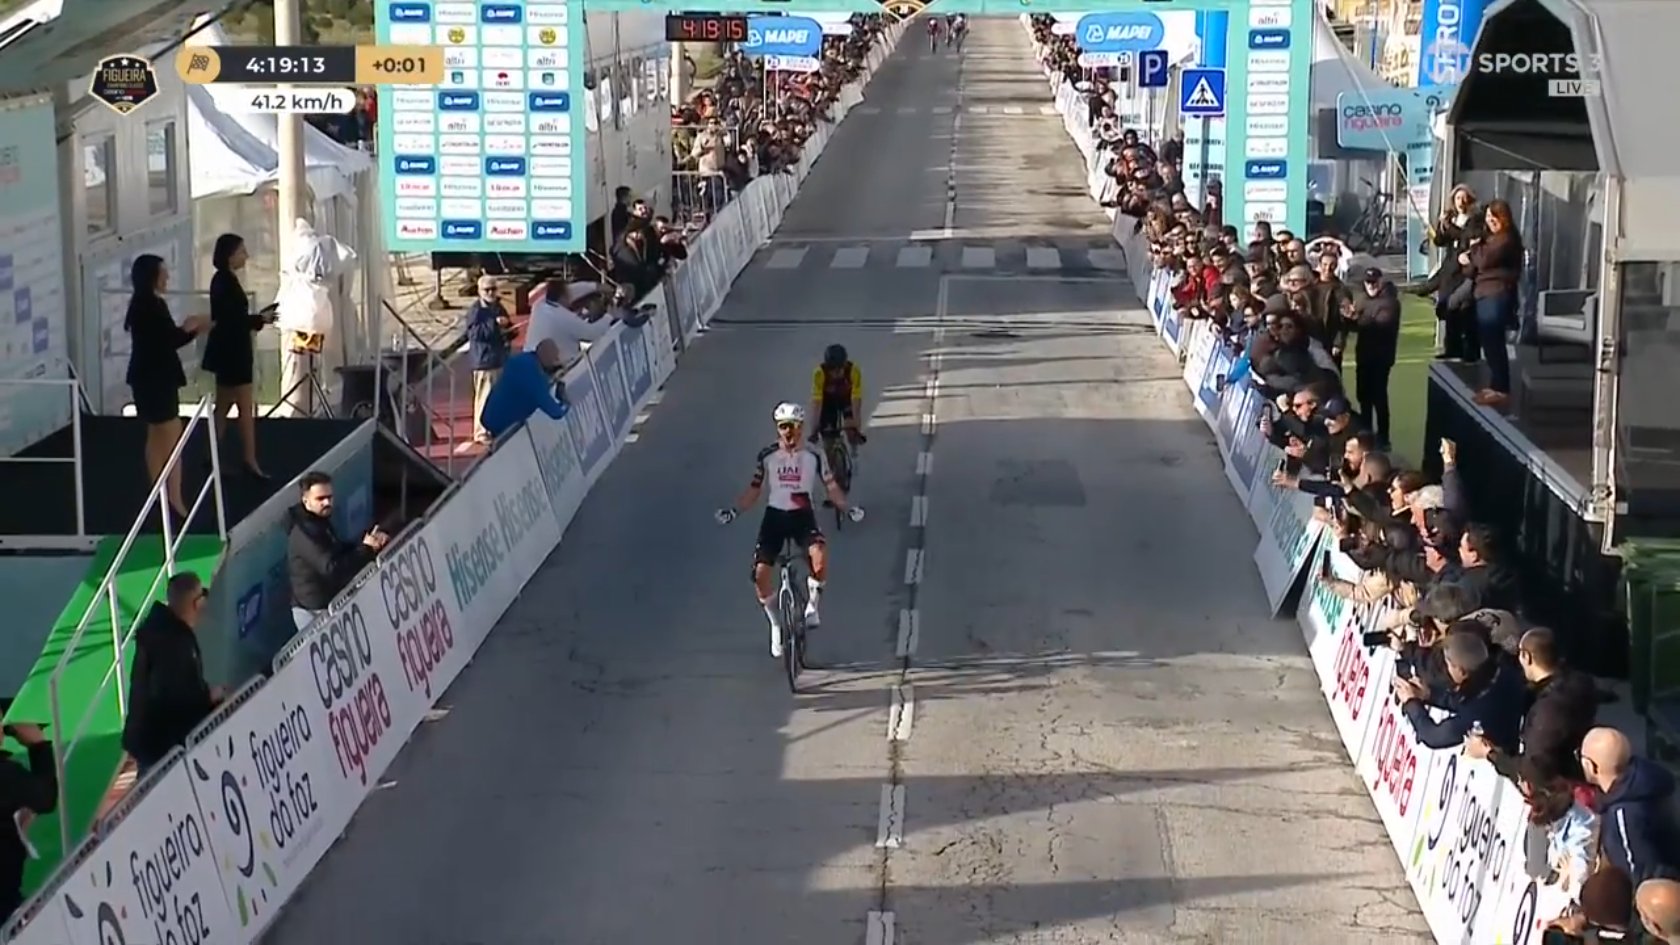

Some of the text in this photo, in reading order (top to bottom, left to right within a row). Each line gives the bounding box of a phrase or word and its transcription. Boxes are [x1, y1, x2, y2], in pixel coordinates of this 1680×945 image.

[764, 29, 809, 44] MAPEI
[1105, 25, 1152, 40] MAPEI
[1145, 54, 1162, 83] P
[1343, 103, 1403, 119] casino
[380, 536, 437, 630] casino
[445, 521, 504, 612] Hisense
[493, 476, 548, 553] Hisense
[310, 602, 372, 709] casino
[396, 598, 454, 699] figueira
[249, 701, 312, 794] figueira
[328, 672, 392, 787] figueira
[286, 772, 318, 826] foz
[1457, 769, 1506, 882] figueira
[129, 812, 204, 923] figueira
[1457, 859, 1482, 938] foz
